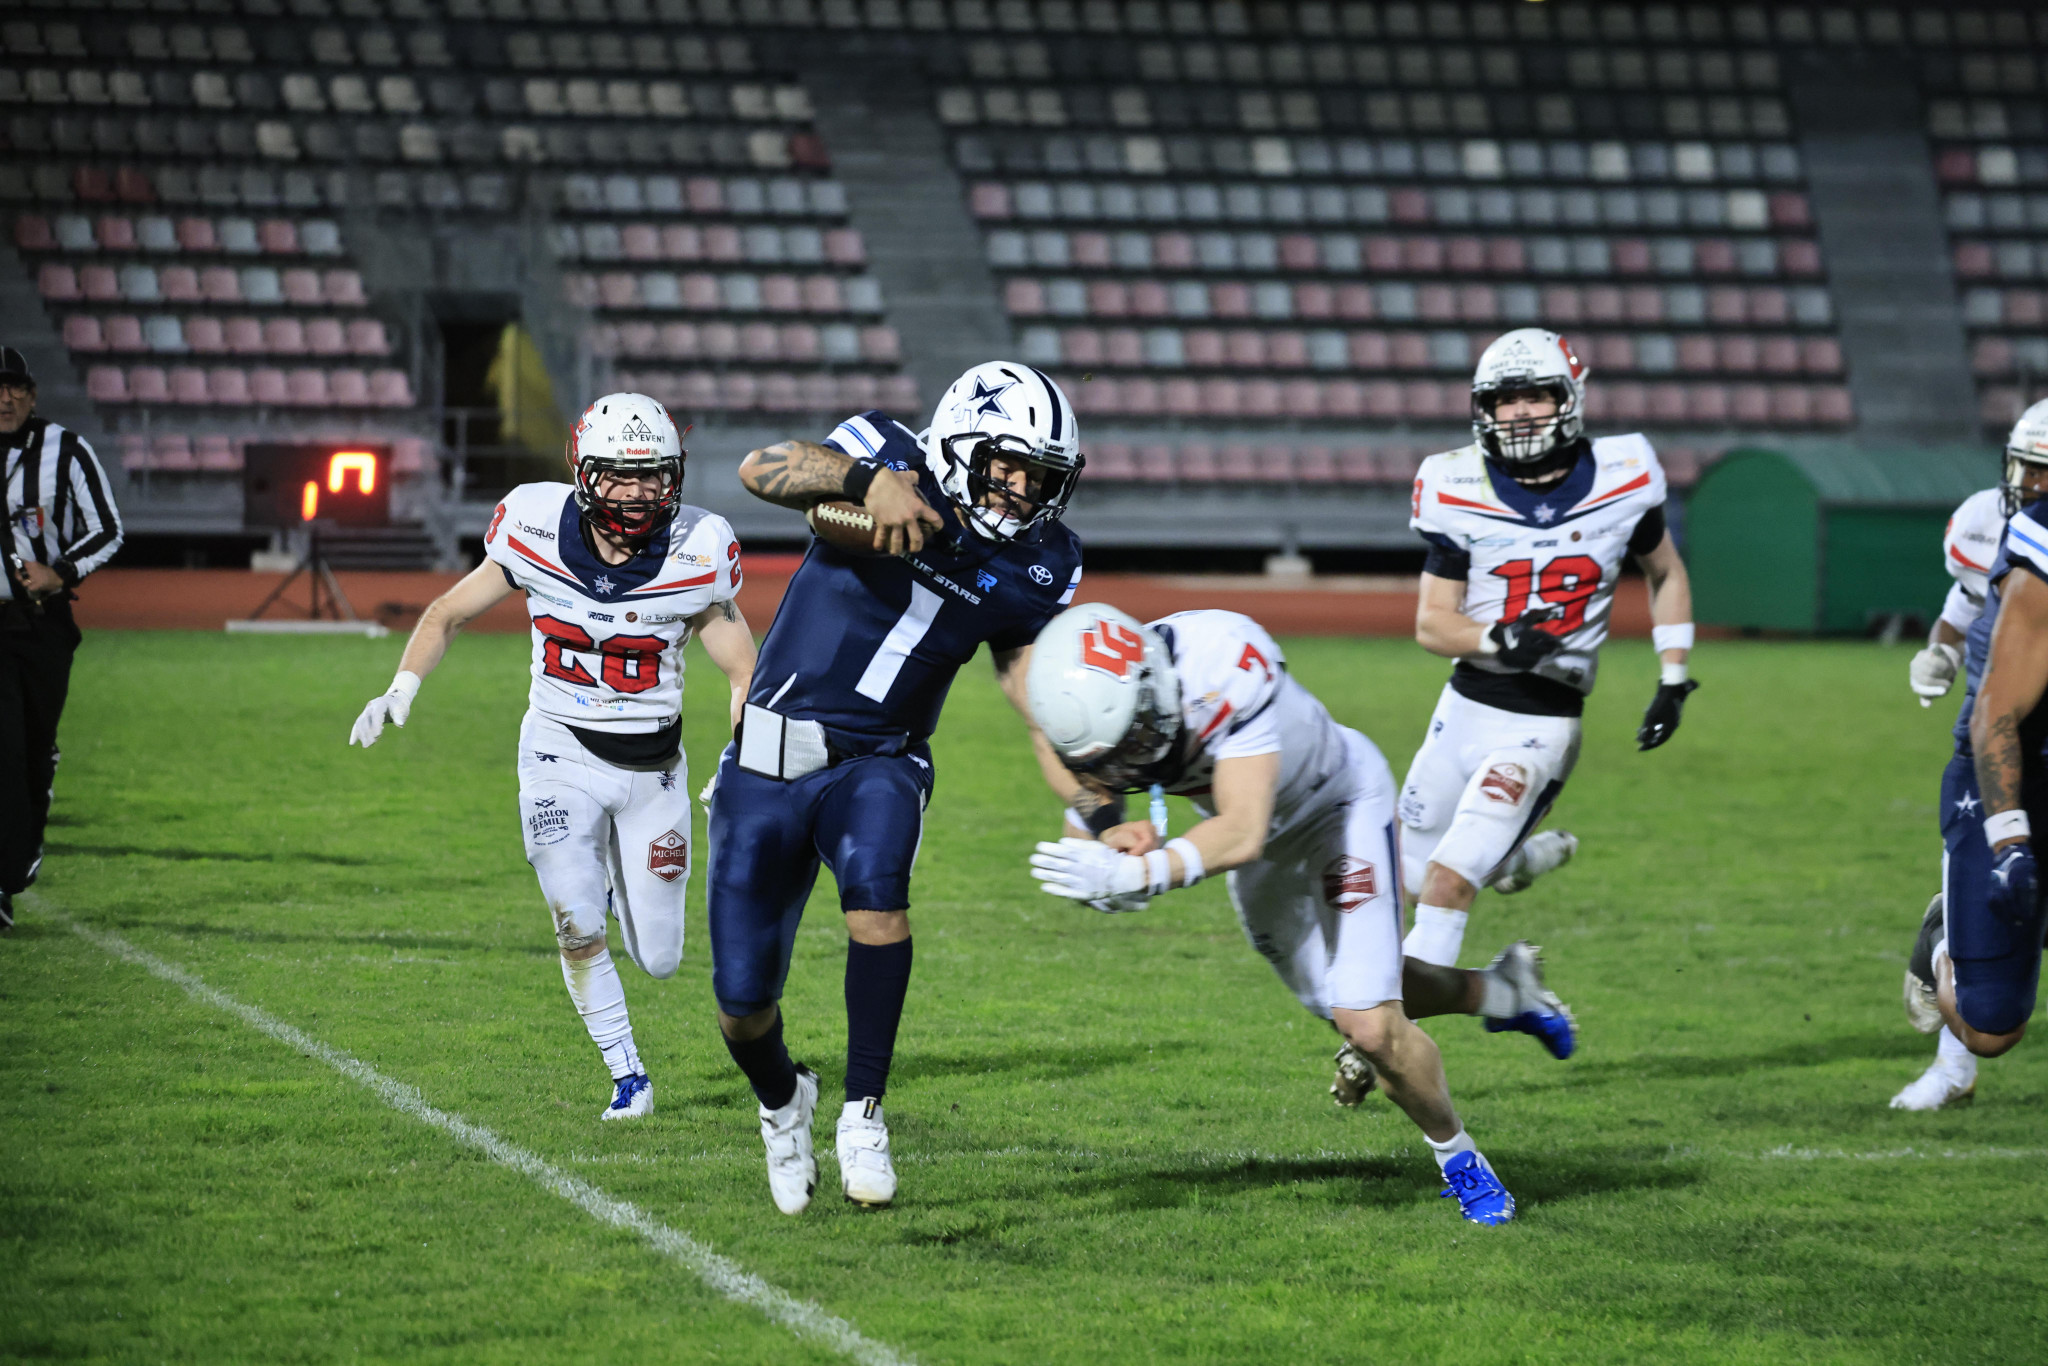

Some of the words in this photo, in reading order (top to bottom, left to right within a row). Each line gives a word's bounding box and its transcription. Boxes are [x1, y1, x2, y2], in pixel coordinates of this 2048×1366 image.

[640, 434, 665, 443] EVENT
[523, 525, 556, 540] acqua
[898, 549, 934, 577] LUE
[933, 573, 982, 606] STARS
[1486, 554, 1604, 637] 19
[855, 580, 945, 704] 1
[1236, 641, 1276, 684] 7
[529, 815, 537, 825] LE
[537, 809, 569, 820] SALON
[653, 849, 685, 858] MICHELI
